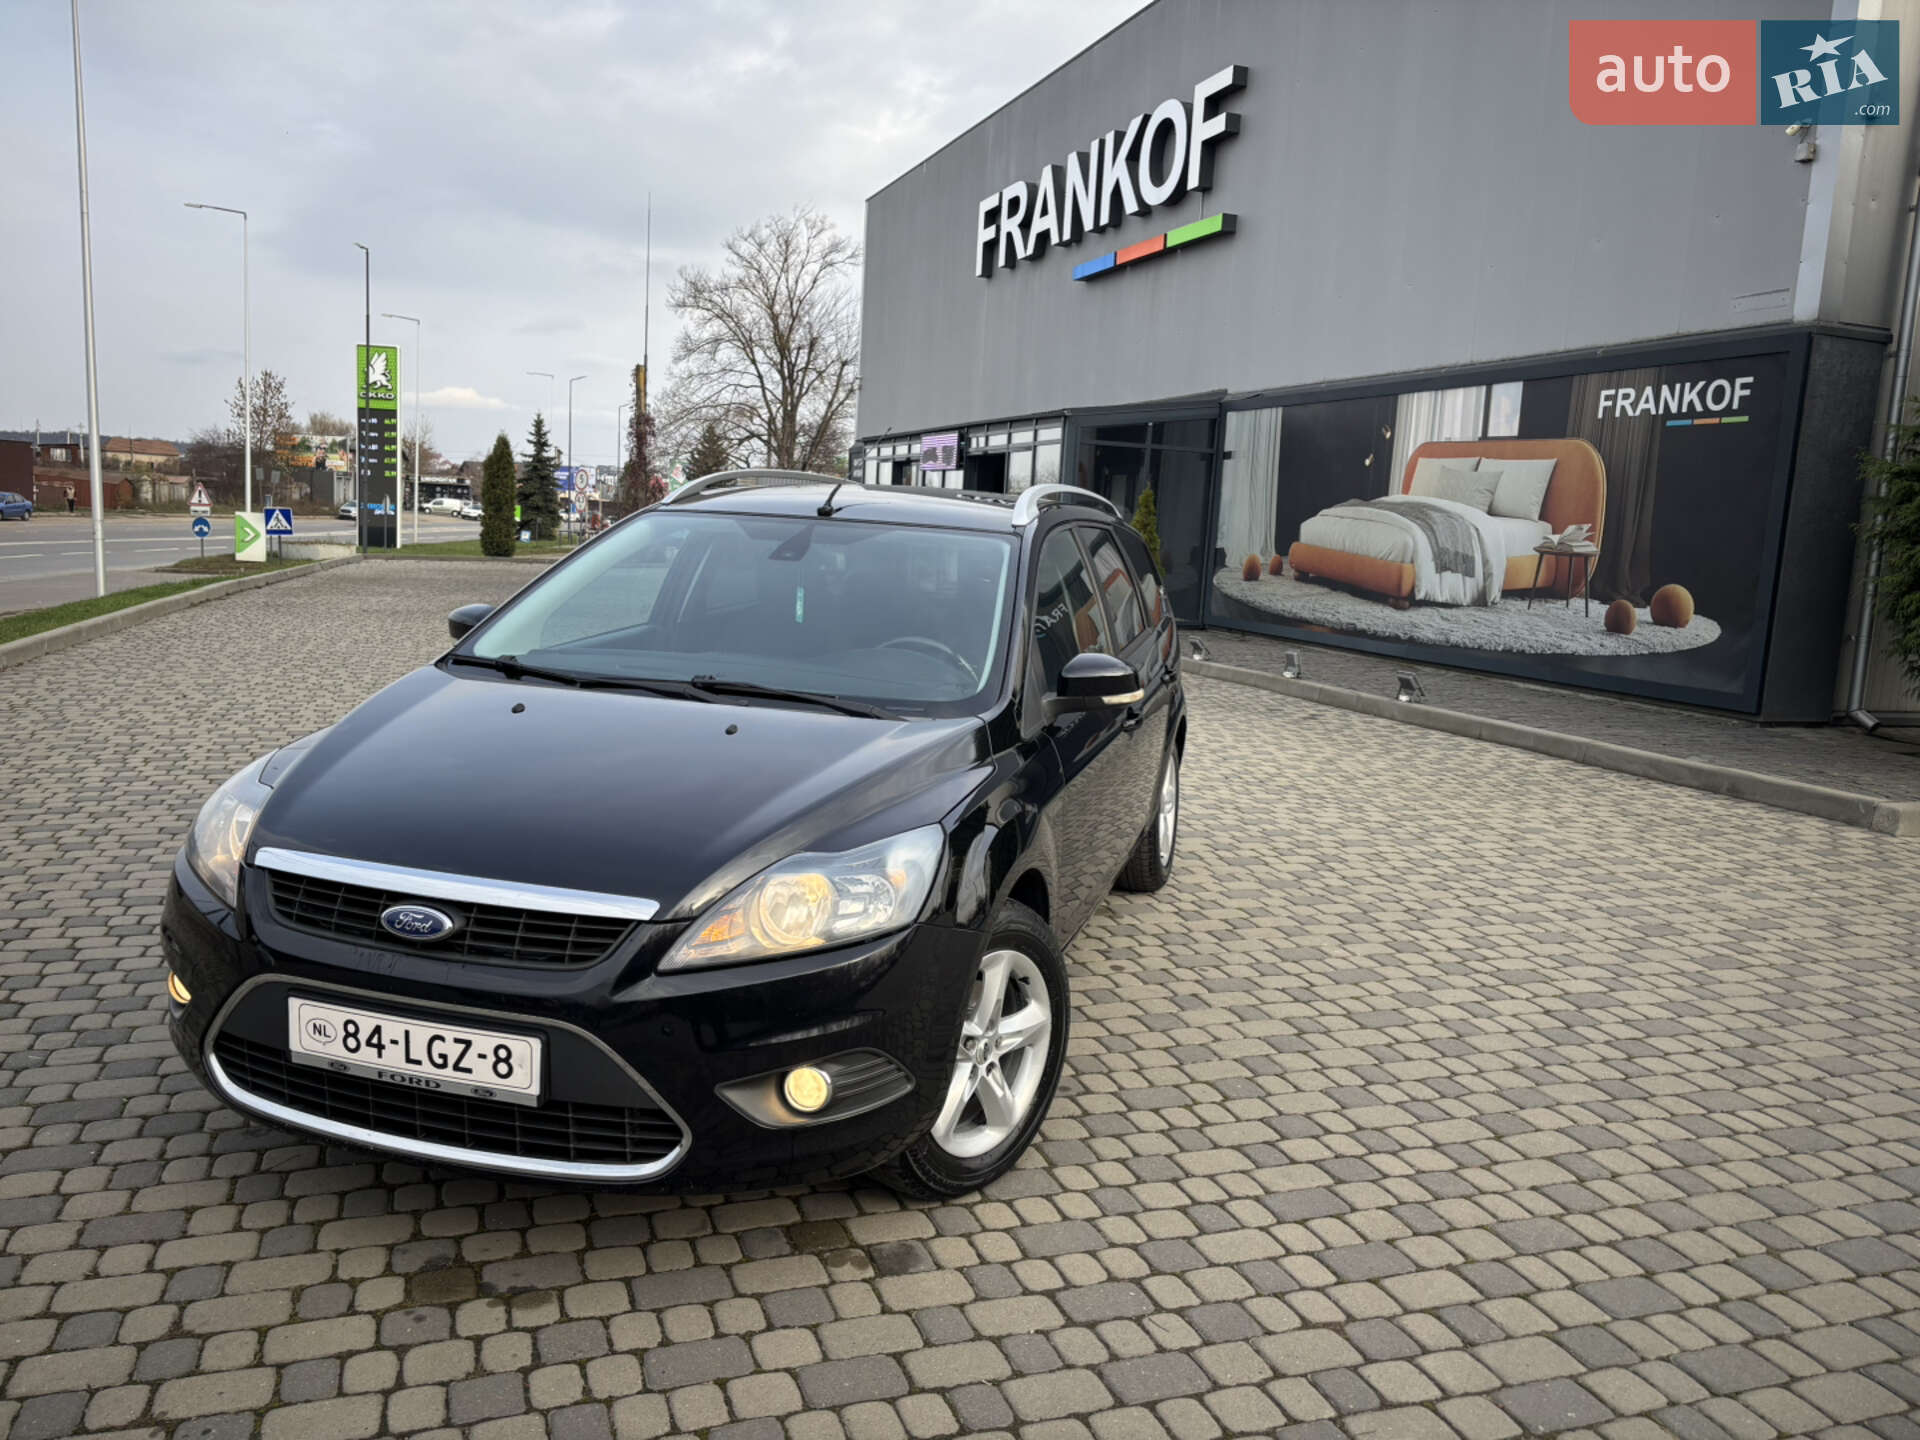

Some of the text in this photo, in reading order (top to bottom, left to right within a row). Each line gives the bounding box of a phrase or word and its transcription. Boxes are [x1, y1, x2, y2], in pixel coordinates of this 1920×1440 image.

[976, 64, 1248, 278] FRANKOF
[1597, 376, 1755, 420] FRANKOF
[395, 911, 433, 933] Ford
[313, 1023, 332, 1039] NL
[342, 1018, 514, 1080] 84-LGZ-8
[377, 1070, 441, 1089] FORD
